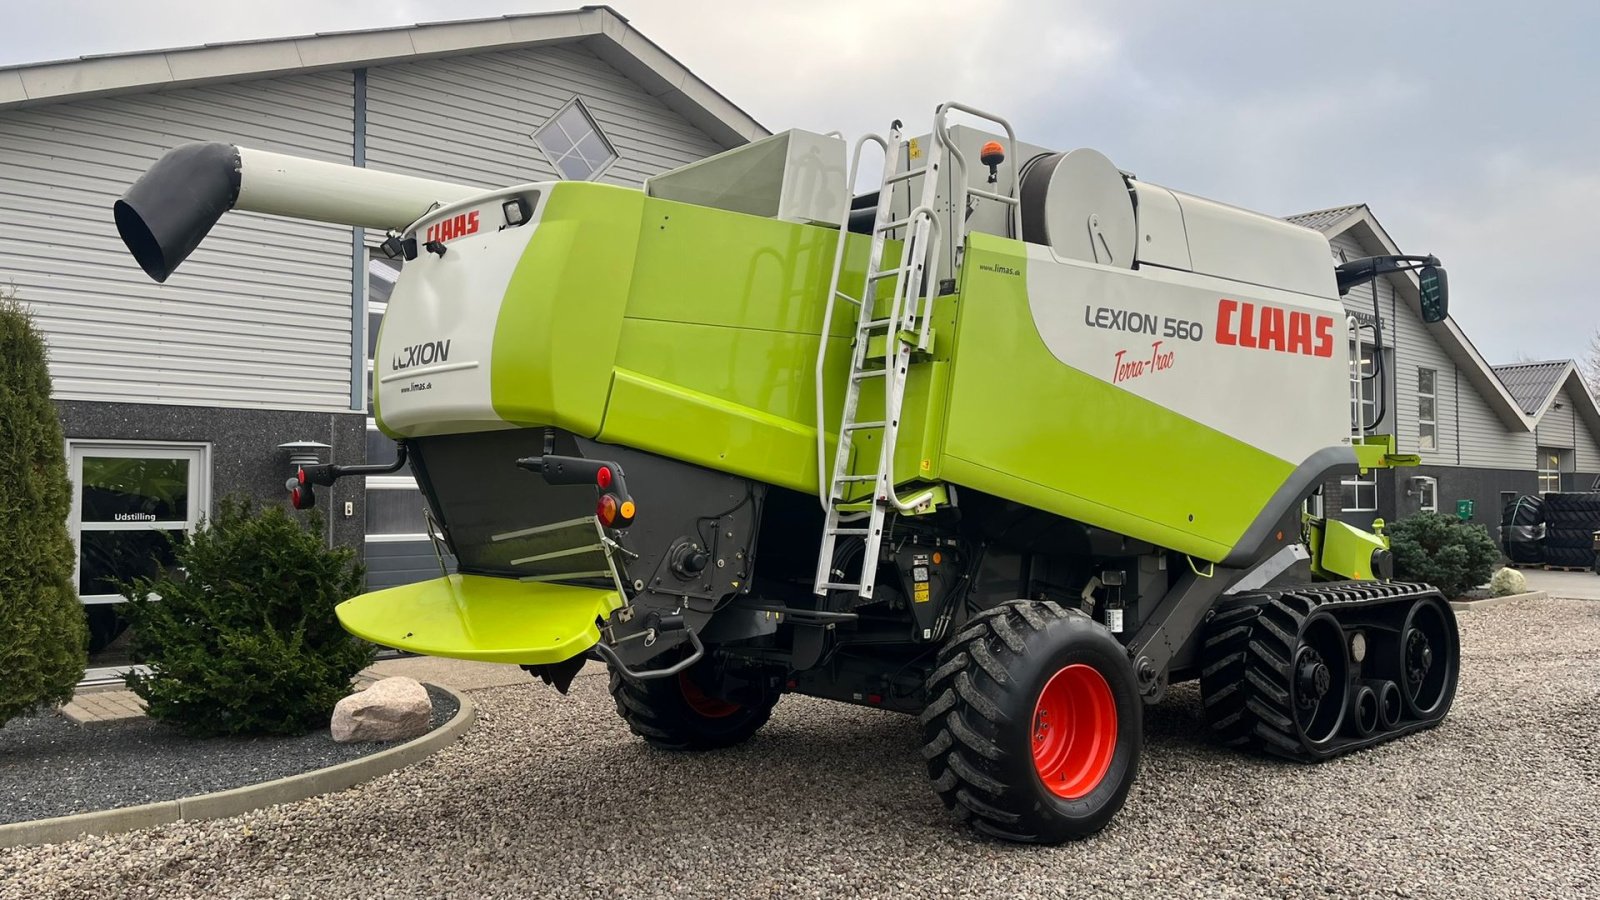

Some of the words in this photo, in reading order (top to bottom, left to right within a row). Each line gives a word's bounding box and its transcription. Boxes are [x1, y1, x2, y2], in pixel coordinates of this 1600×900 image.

[980, 264, 1020, 276] www.limas.dk
[1085, 305, 1157, 335] LEXION
[1163, 318, 1204, 341] 560
[1215, 299, 1333, 358] CLAAS
[1113, 341, 1174, 384] Terra-Trac
[401, 382, 432, 393] www.limas.dk
[114, 513, 156, 522] Udstilling
